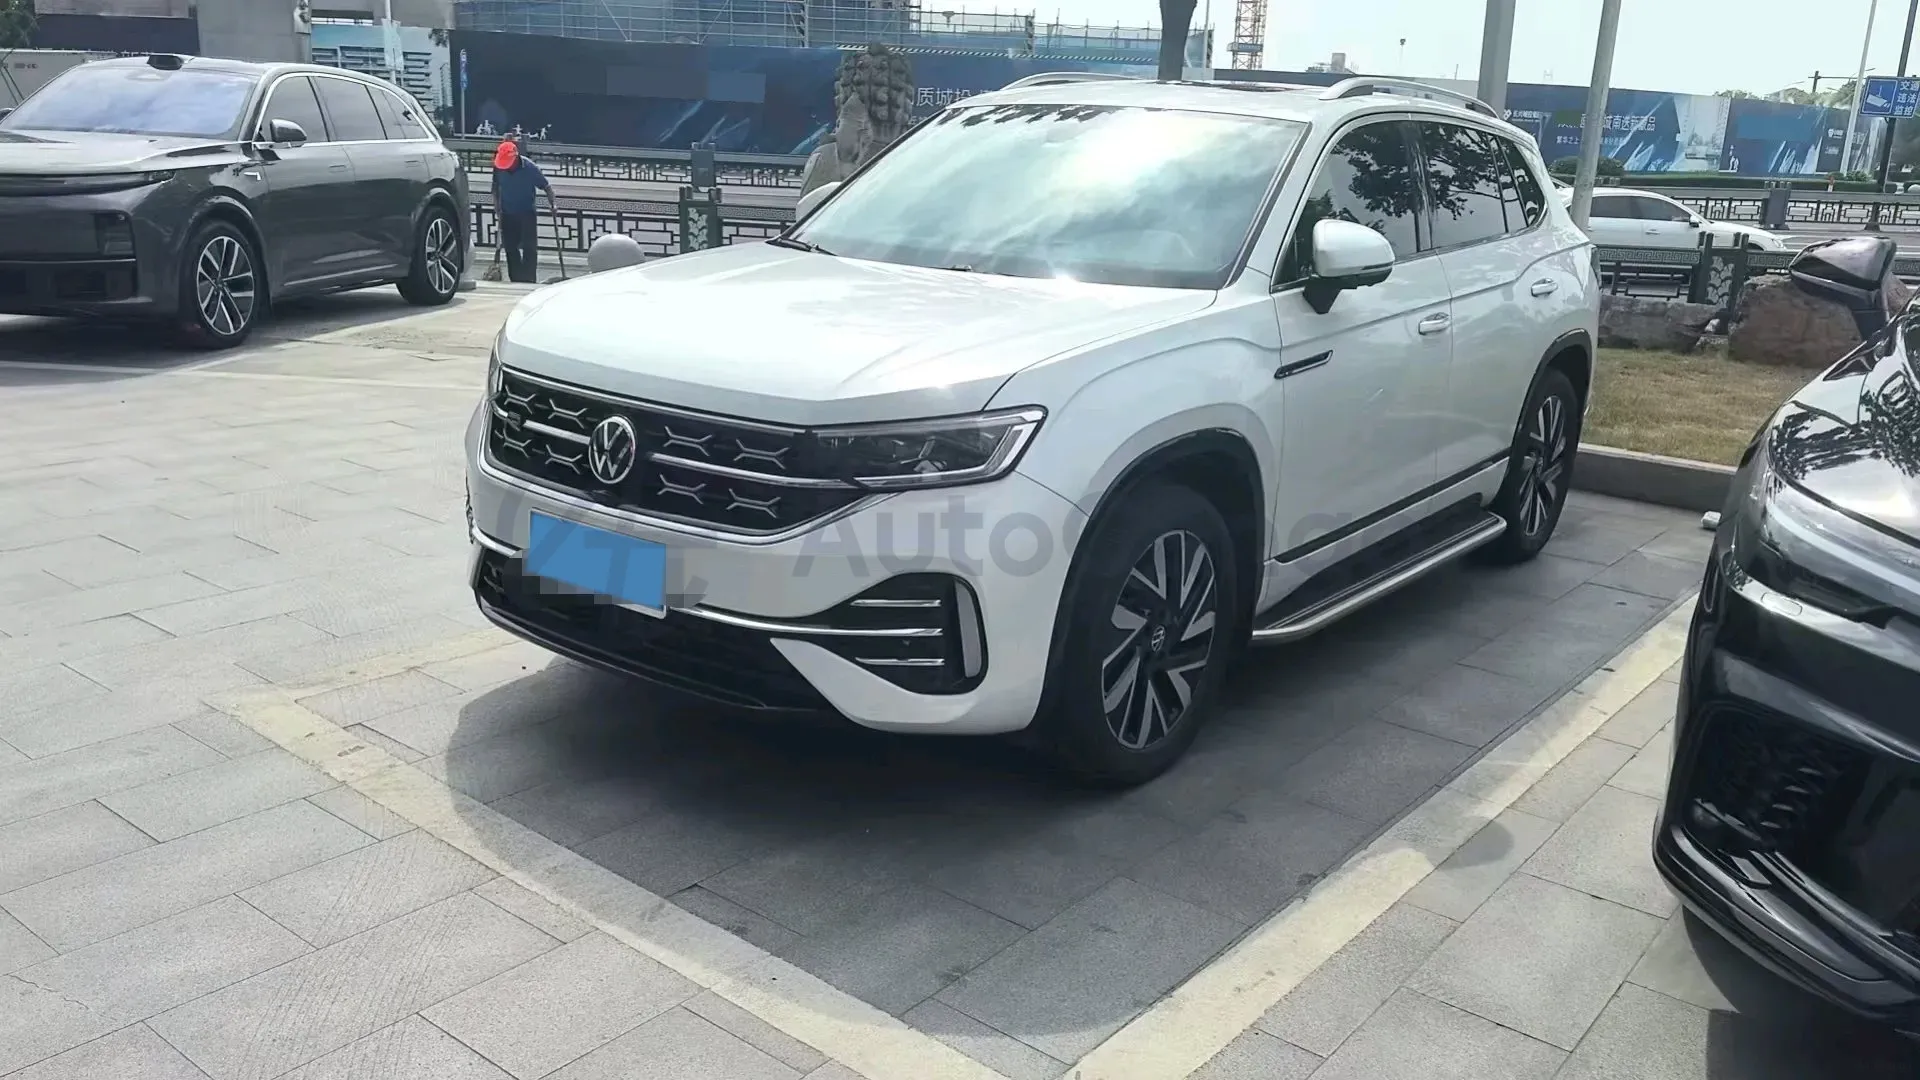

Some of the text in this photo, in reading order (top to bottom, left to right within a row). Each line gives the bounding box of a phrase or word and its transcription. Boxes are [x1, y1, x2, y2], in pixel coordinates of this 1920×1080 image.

[1899, 80, 1919, 91] 交通
[1897, 93, 1917, 103] 违法
[1894, 105, 1914, 116] 监控
